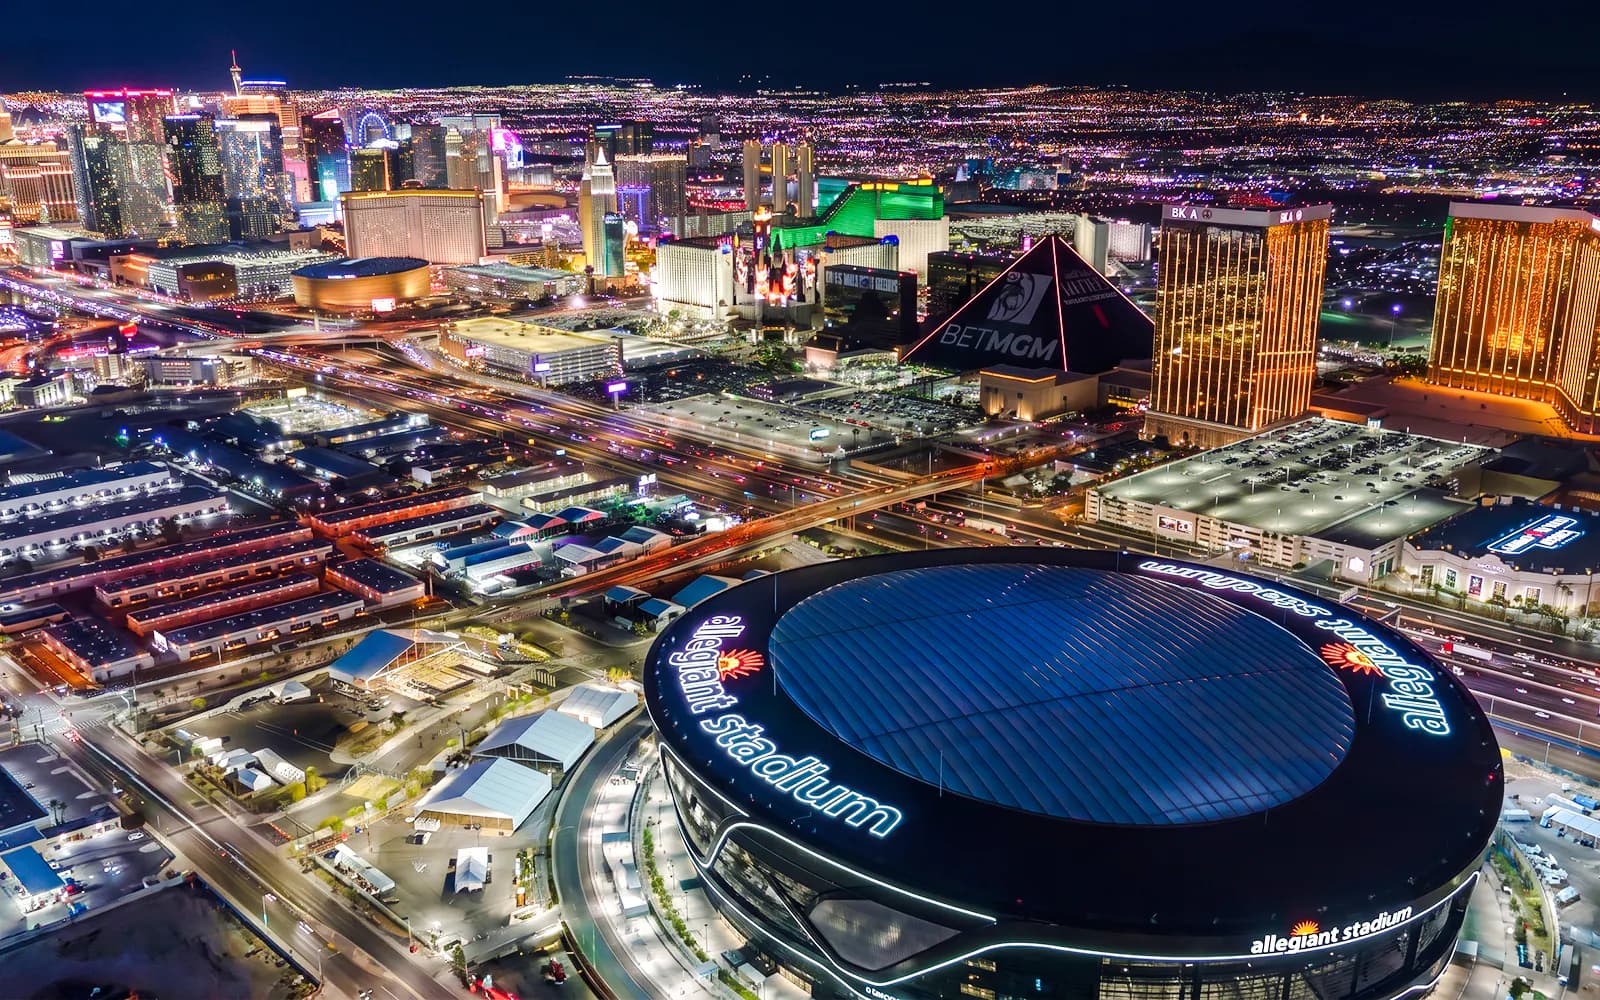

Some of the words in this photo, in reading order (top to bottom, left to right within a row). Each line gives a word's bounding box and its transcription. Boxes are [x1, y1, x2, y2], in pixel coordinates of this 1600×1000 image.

[940, 323, 1058, 361] BETMGM
[1139, 561, 1331, 616] stadium
[669, 615, 745, 714] allegiant
[1315, 619, 1450, 735] allegiant
[700, 715, 903, 838] stadium
[1250, 932, 1340, 955] allegiant
[1342, 906, 1413, 941] stadium
